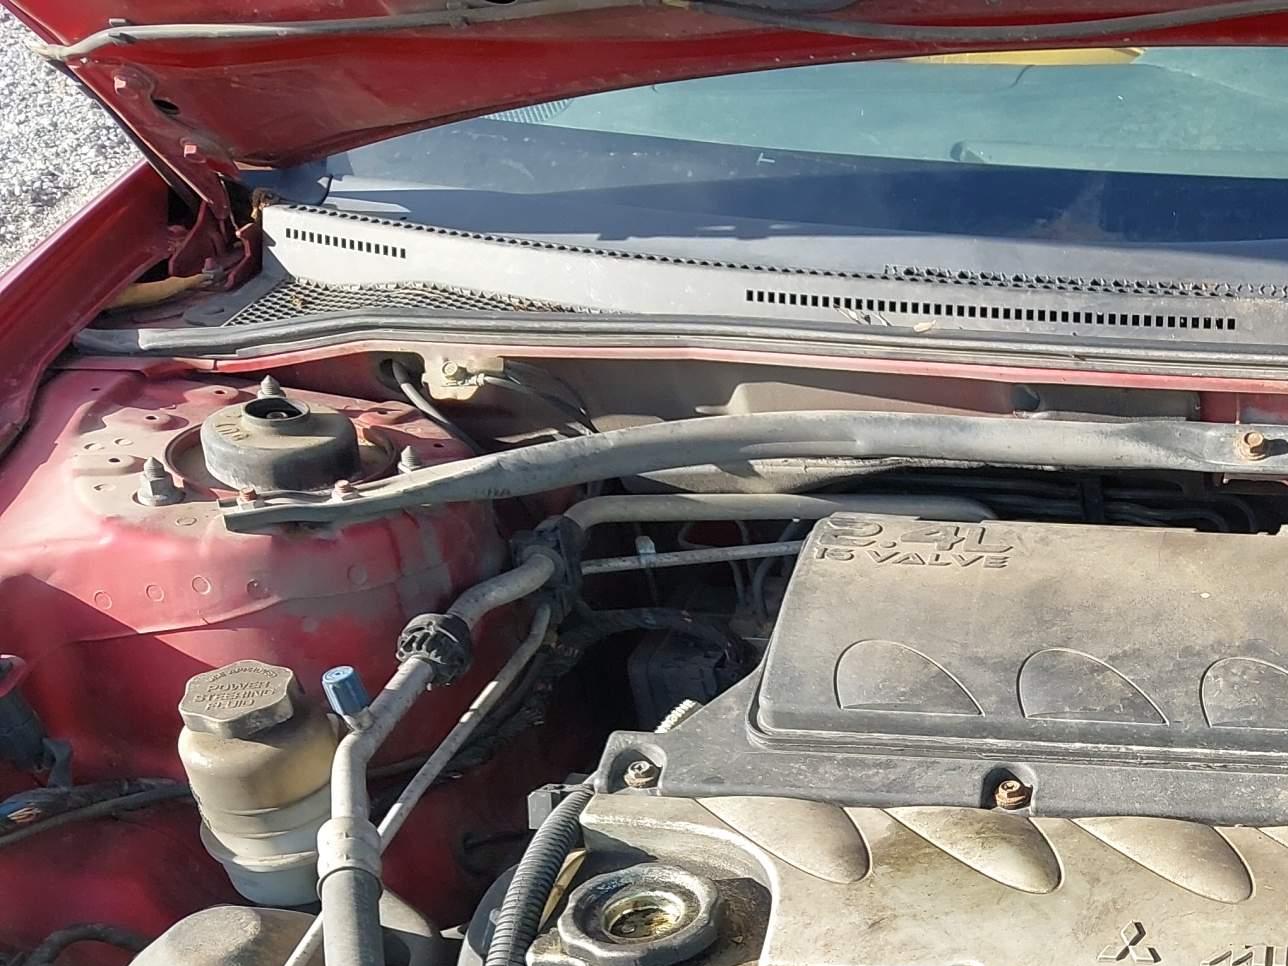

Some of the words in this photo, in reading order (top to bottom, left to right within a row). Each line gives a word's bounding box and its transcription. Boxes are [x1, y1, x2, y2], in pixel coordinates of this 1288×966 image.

[818, 517, 1014, 553] 2.4L
[868, 551, 1012, 570] VALVE
[207, 680, 272, 693] POWER
[192, 688, 277, 703] STEERING
[205, 699, 256, 712] FLUID
